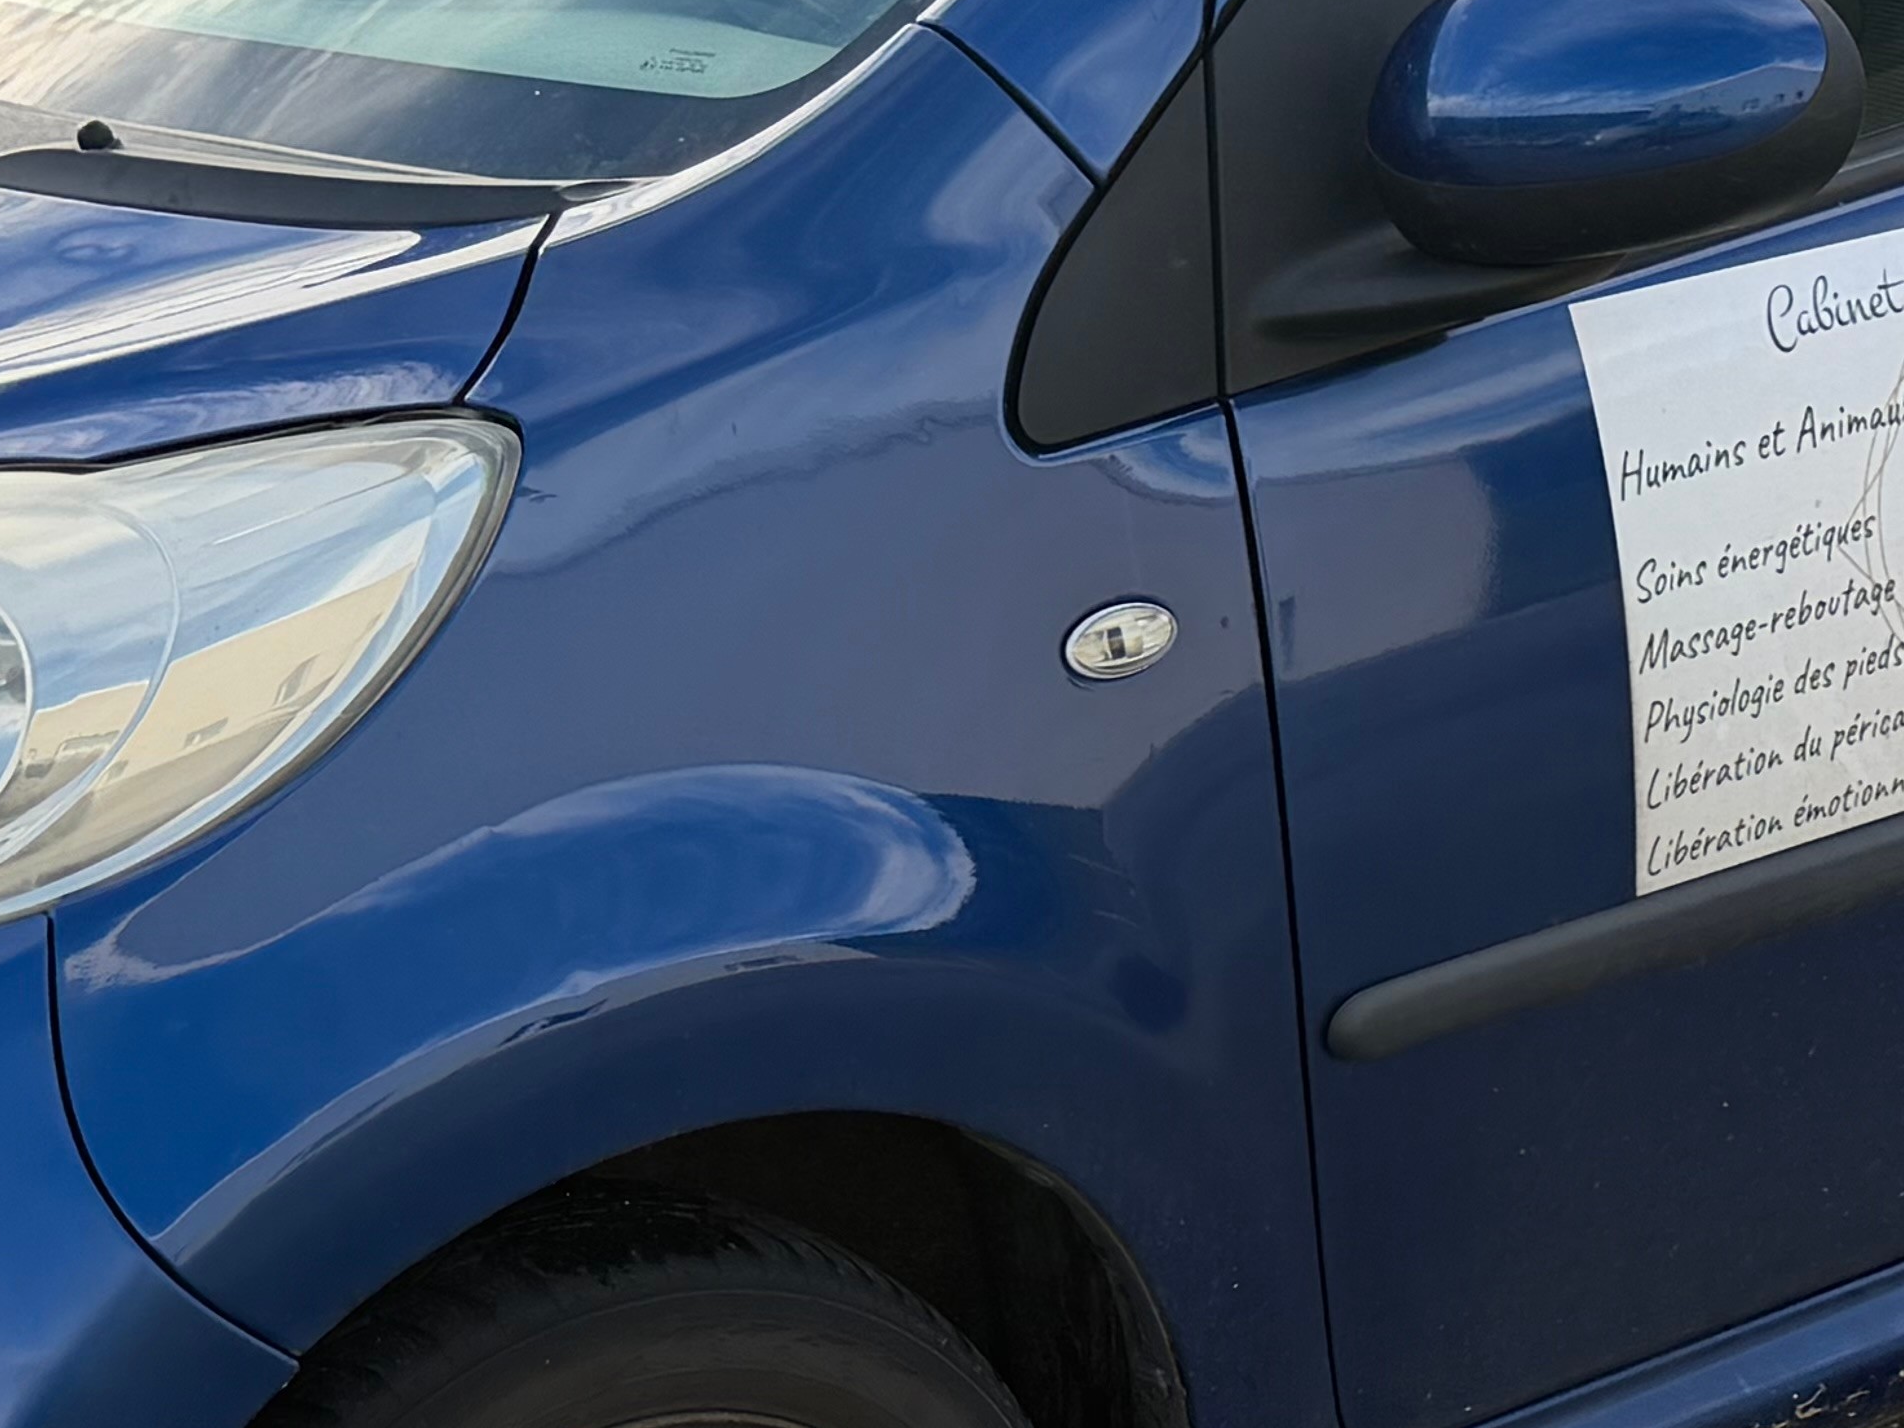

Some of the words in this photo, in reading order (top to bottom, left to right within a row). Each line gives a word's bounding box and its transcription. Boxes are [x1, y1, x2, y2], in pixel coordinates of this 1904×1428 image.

[1766, 268, 1904, 353] Cabinet
[1621, 440, 1746, 501] Humains
[1758, 421, 1788, 459] et
[1636, 557, 1707, 604] Soins
[1717, 515, 1876, 579] énergétiques
[1639, 578, 1896, 674] Massage-reboutage
[1645, 677, 1785, 744] Physiologie
[1794, 658, 1835, 695] des
[1646, 746, 1784, 810] Libération
[1794, 725, 1821, 762] du
[1647, 814, 1784, 876] Libération
